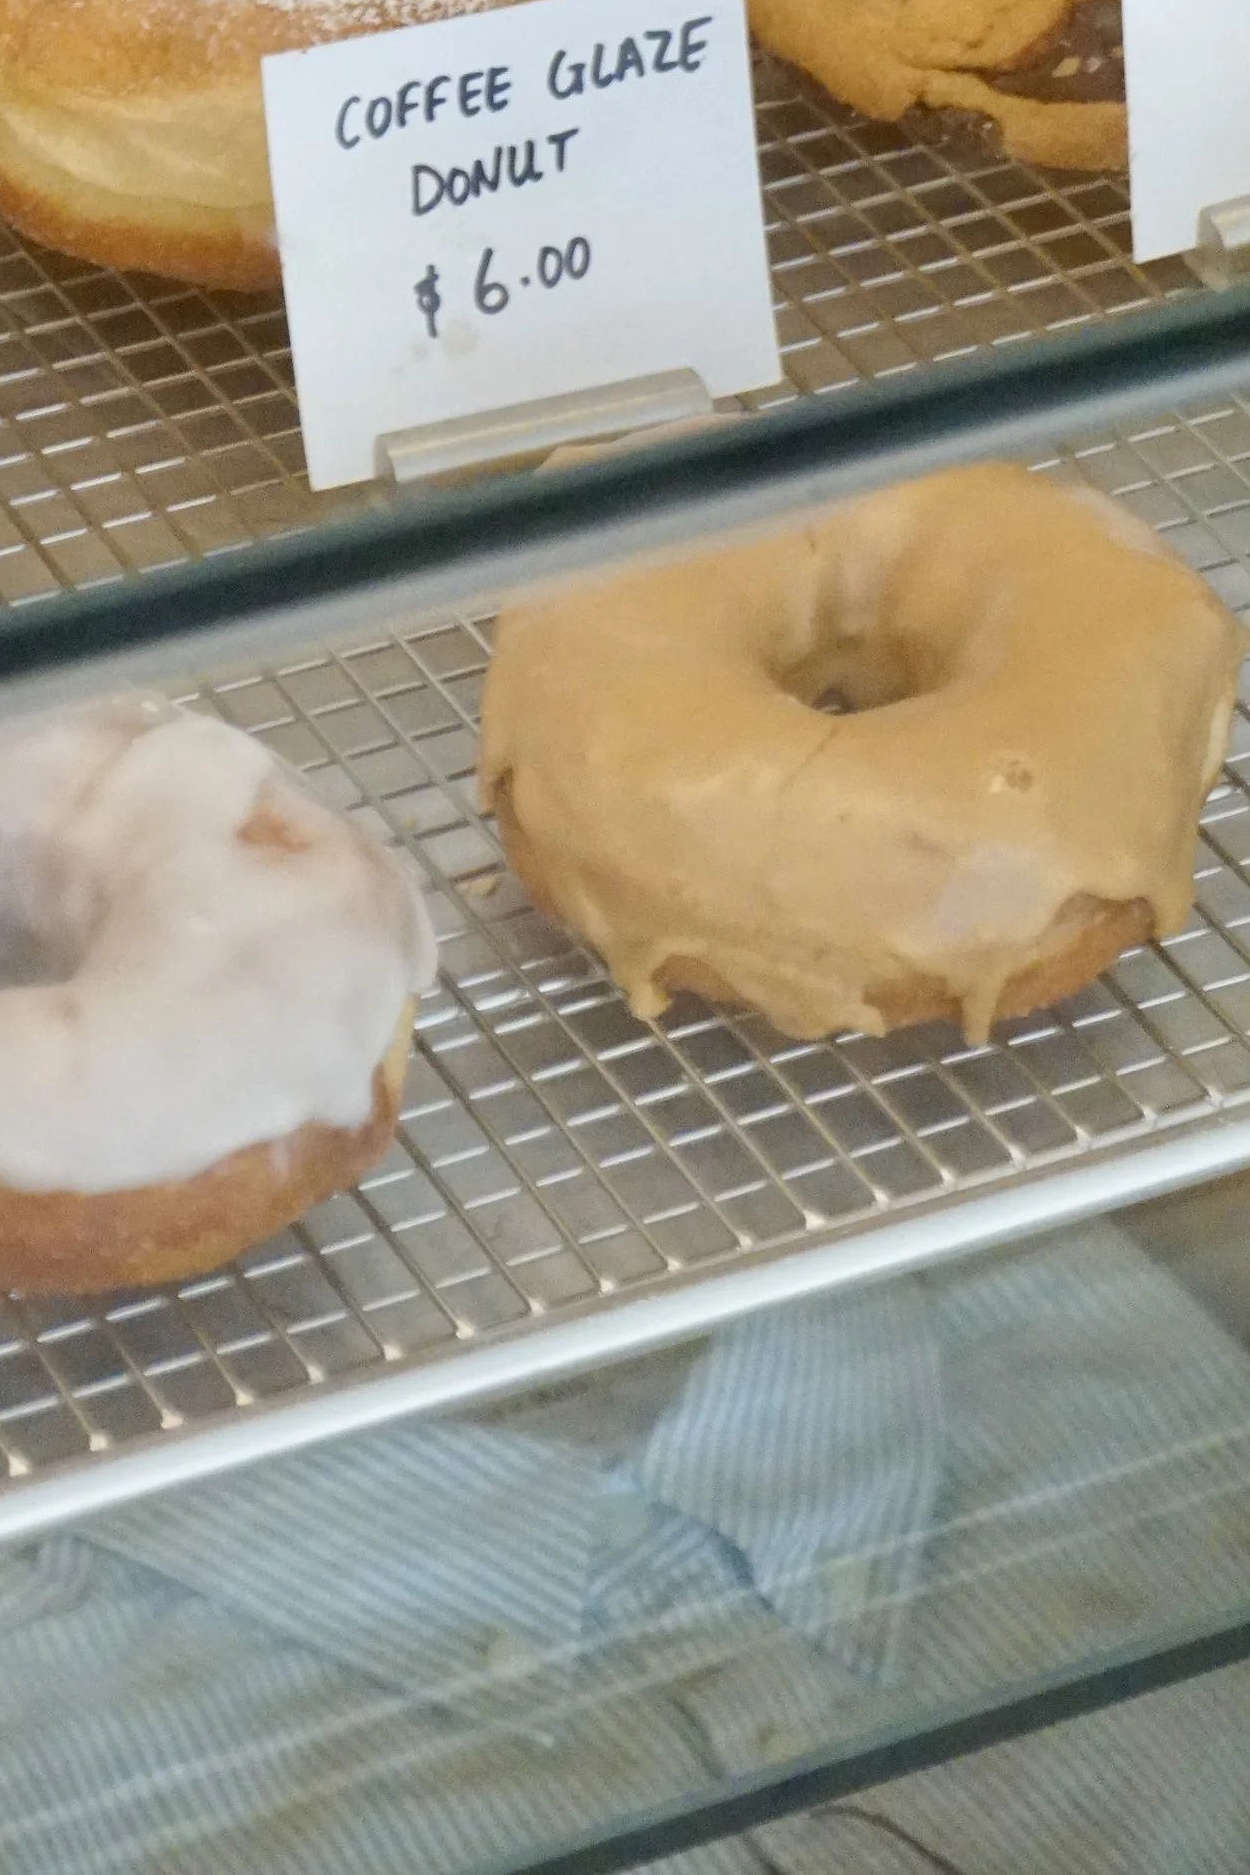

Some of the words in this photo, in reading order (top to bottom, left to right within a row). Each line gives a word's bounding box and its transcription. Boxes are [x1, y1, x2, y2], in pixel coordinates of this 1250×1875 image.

[336, 66, 512, 150] COFFEE
[547, 16, 713, 100] GLAZE
[412, 127, 579, 217] DONUT
